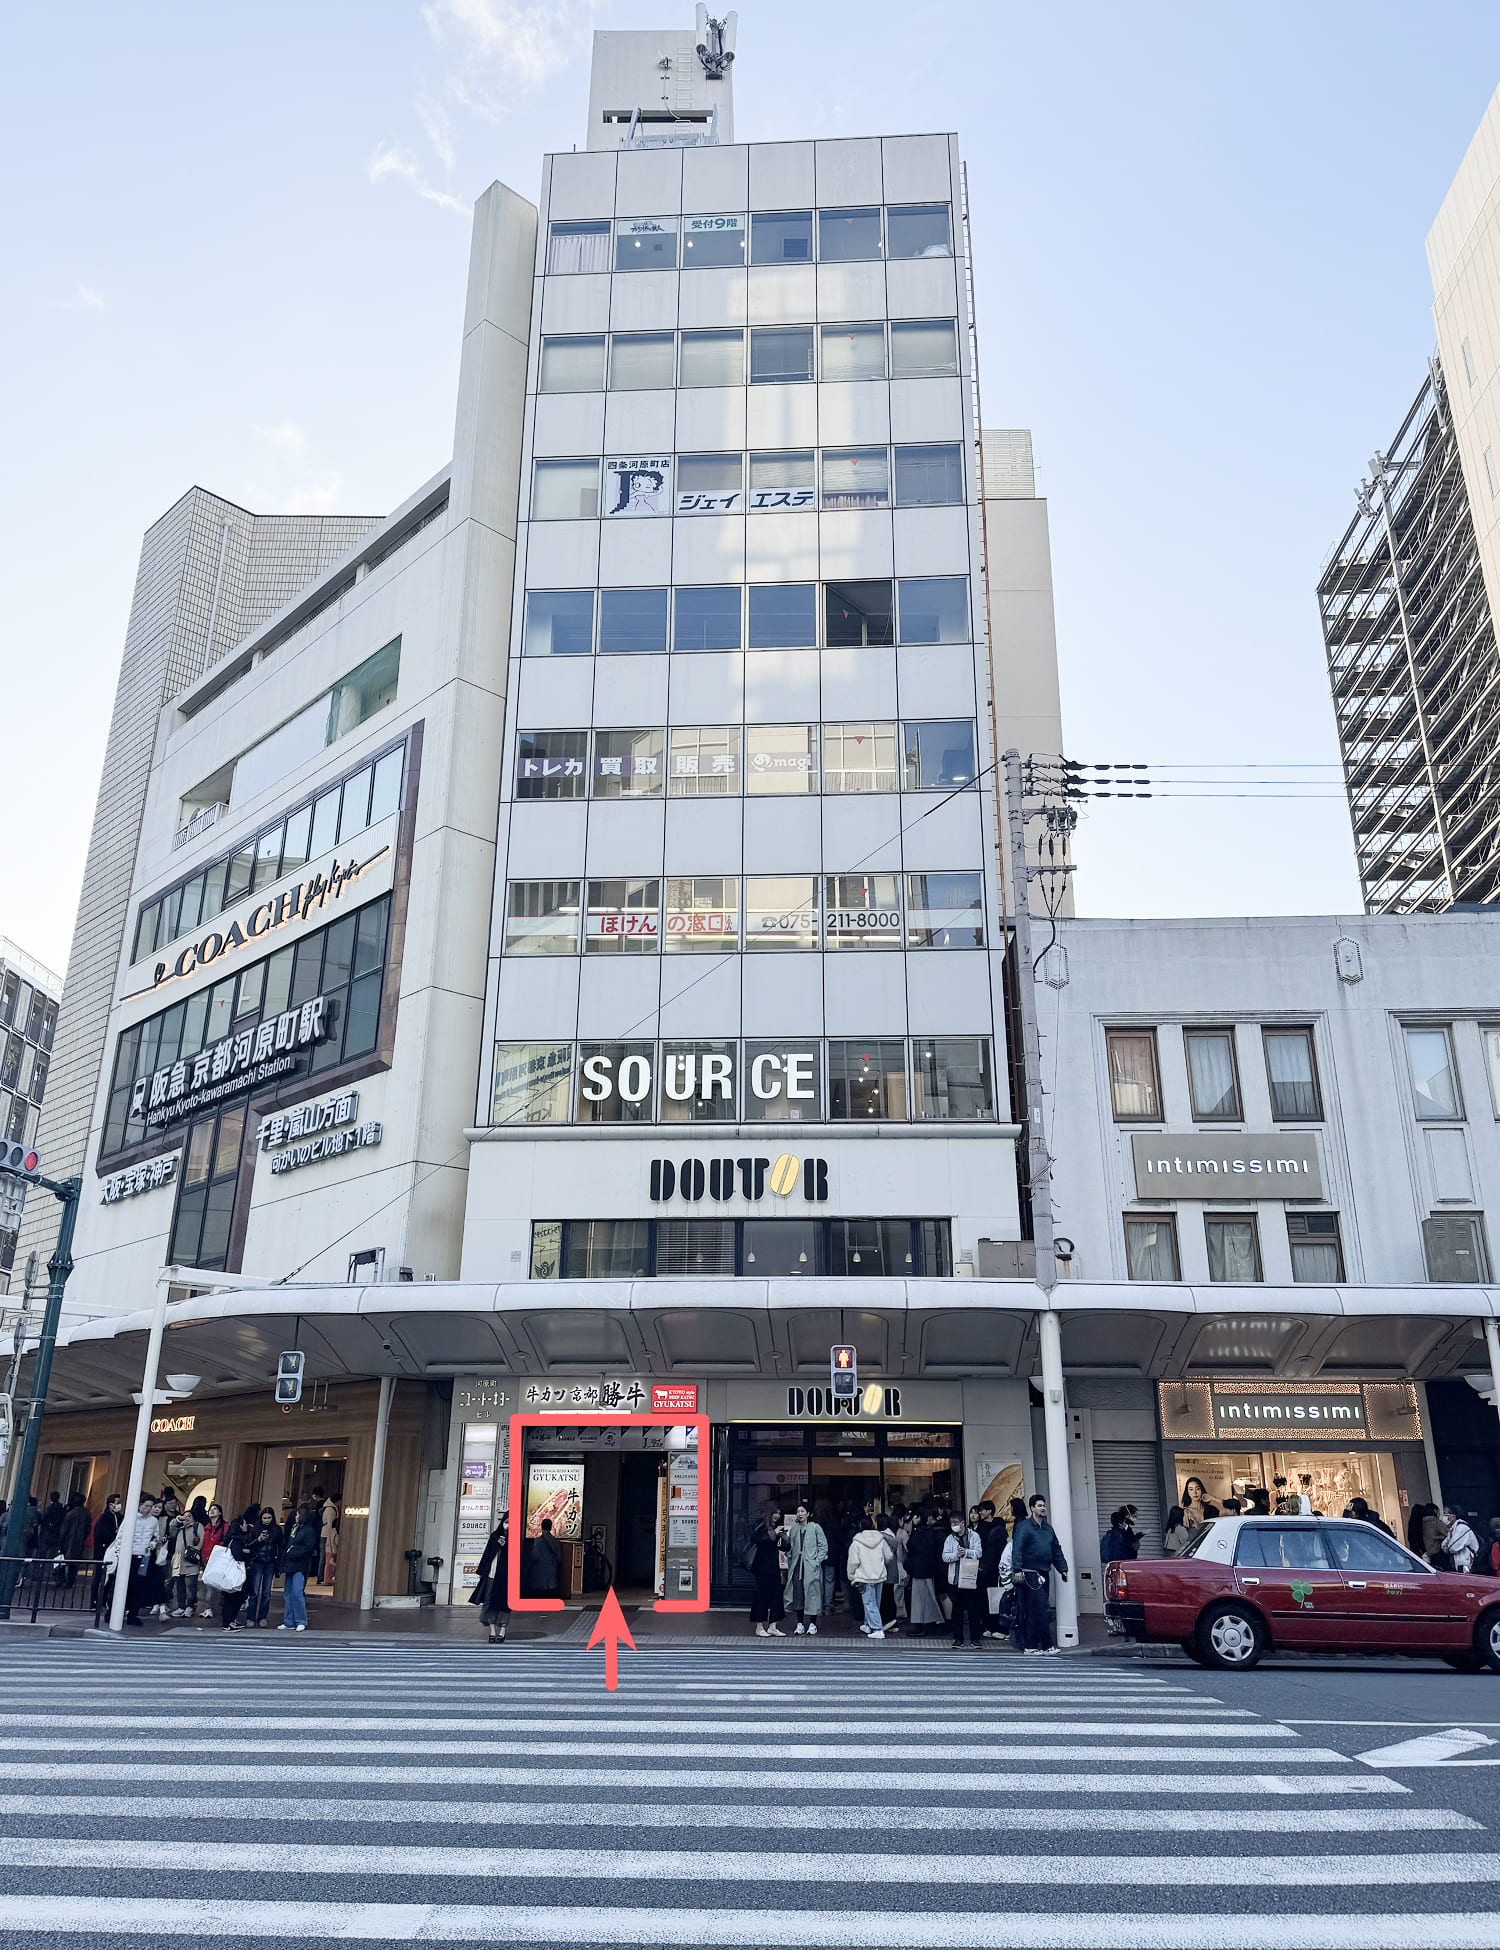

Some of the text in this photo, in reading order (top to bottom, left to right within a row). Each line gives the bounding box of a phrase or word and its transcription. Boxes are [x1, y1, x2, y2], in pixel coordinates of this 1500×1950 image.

[691, 218, 738, 229] 受付9階
[607, 459, 670, 470] 四条河原町店
[175, 883, 303, 977] COACH
[190, 996, 325, 1090] 京都河原町駅
[582, 1053, 815, 1102] SOURCE
[146, 1056, 291, 1126] Hankyu Kyoto-kawaramachi Station
[649, 1153, 829, 1202] DOUTOR
[1146, 1157, 1309, 1175] intimissimi
[526, 1385, 565, 1404] 牛カツ
[602, 1382, 645, 1408] 勝牛
[150, 1415, 195, 1433] COACH
[1219, 1402, 1360, 1420] intimissimi
[533, 1474, 580, 1482] GYUKATSU
[565, 1487, 580, 1535] 牛カツ
